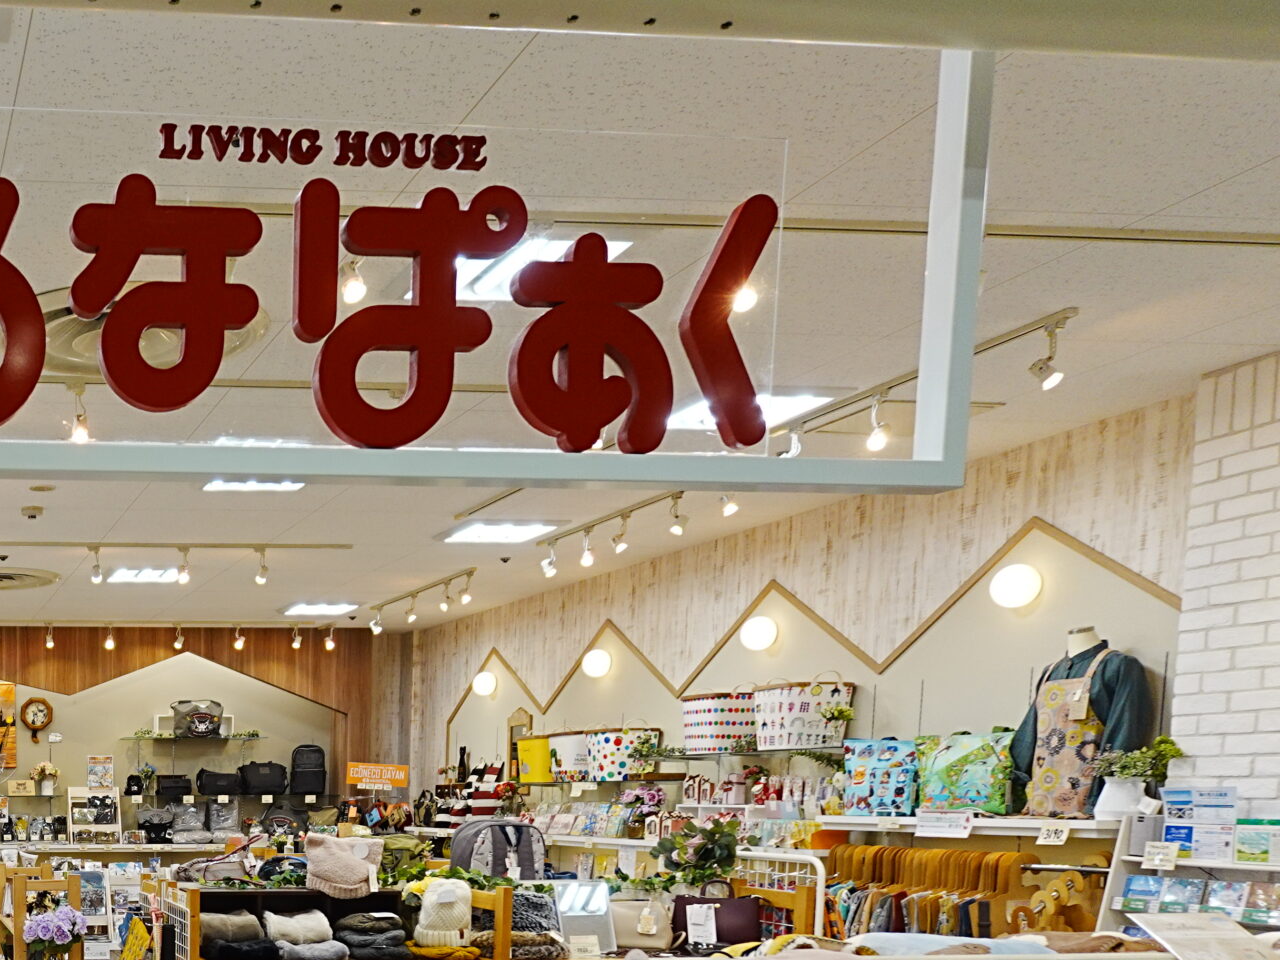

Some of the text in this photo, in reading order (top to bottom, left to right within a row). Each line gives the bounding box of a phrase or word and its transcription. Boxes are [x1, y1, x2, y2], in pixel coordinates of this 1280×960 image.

[158, 123, 488, 171] LIVING HOUSE
[350, 767, 405, 780] ECONECO DAYAN
